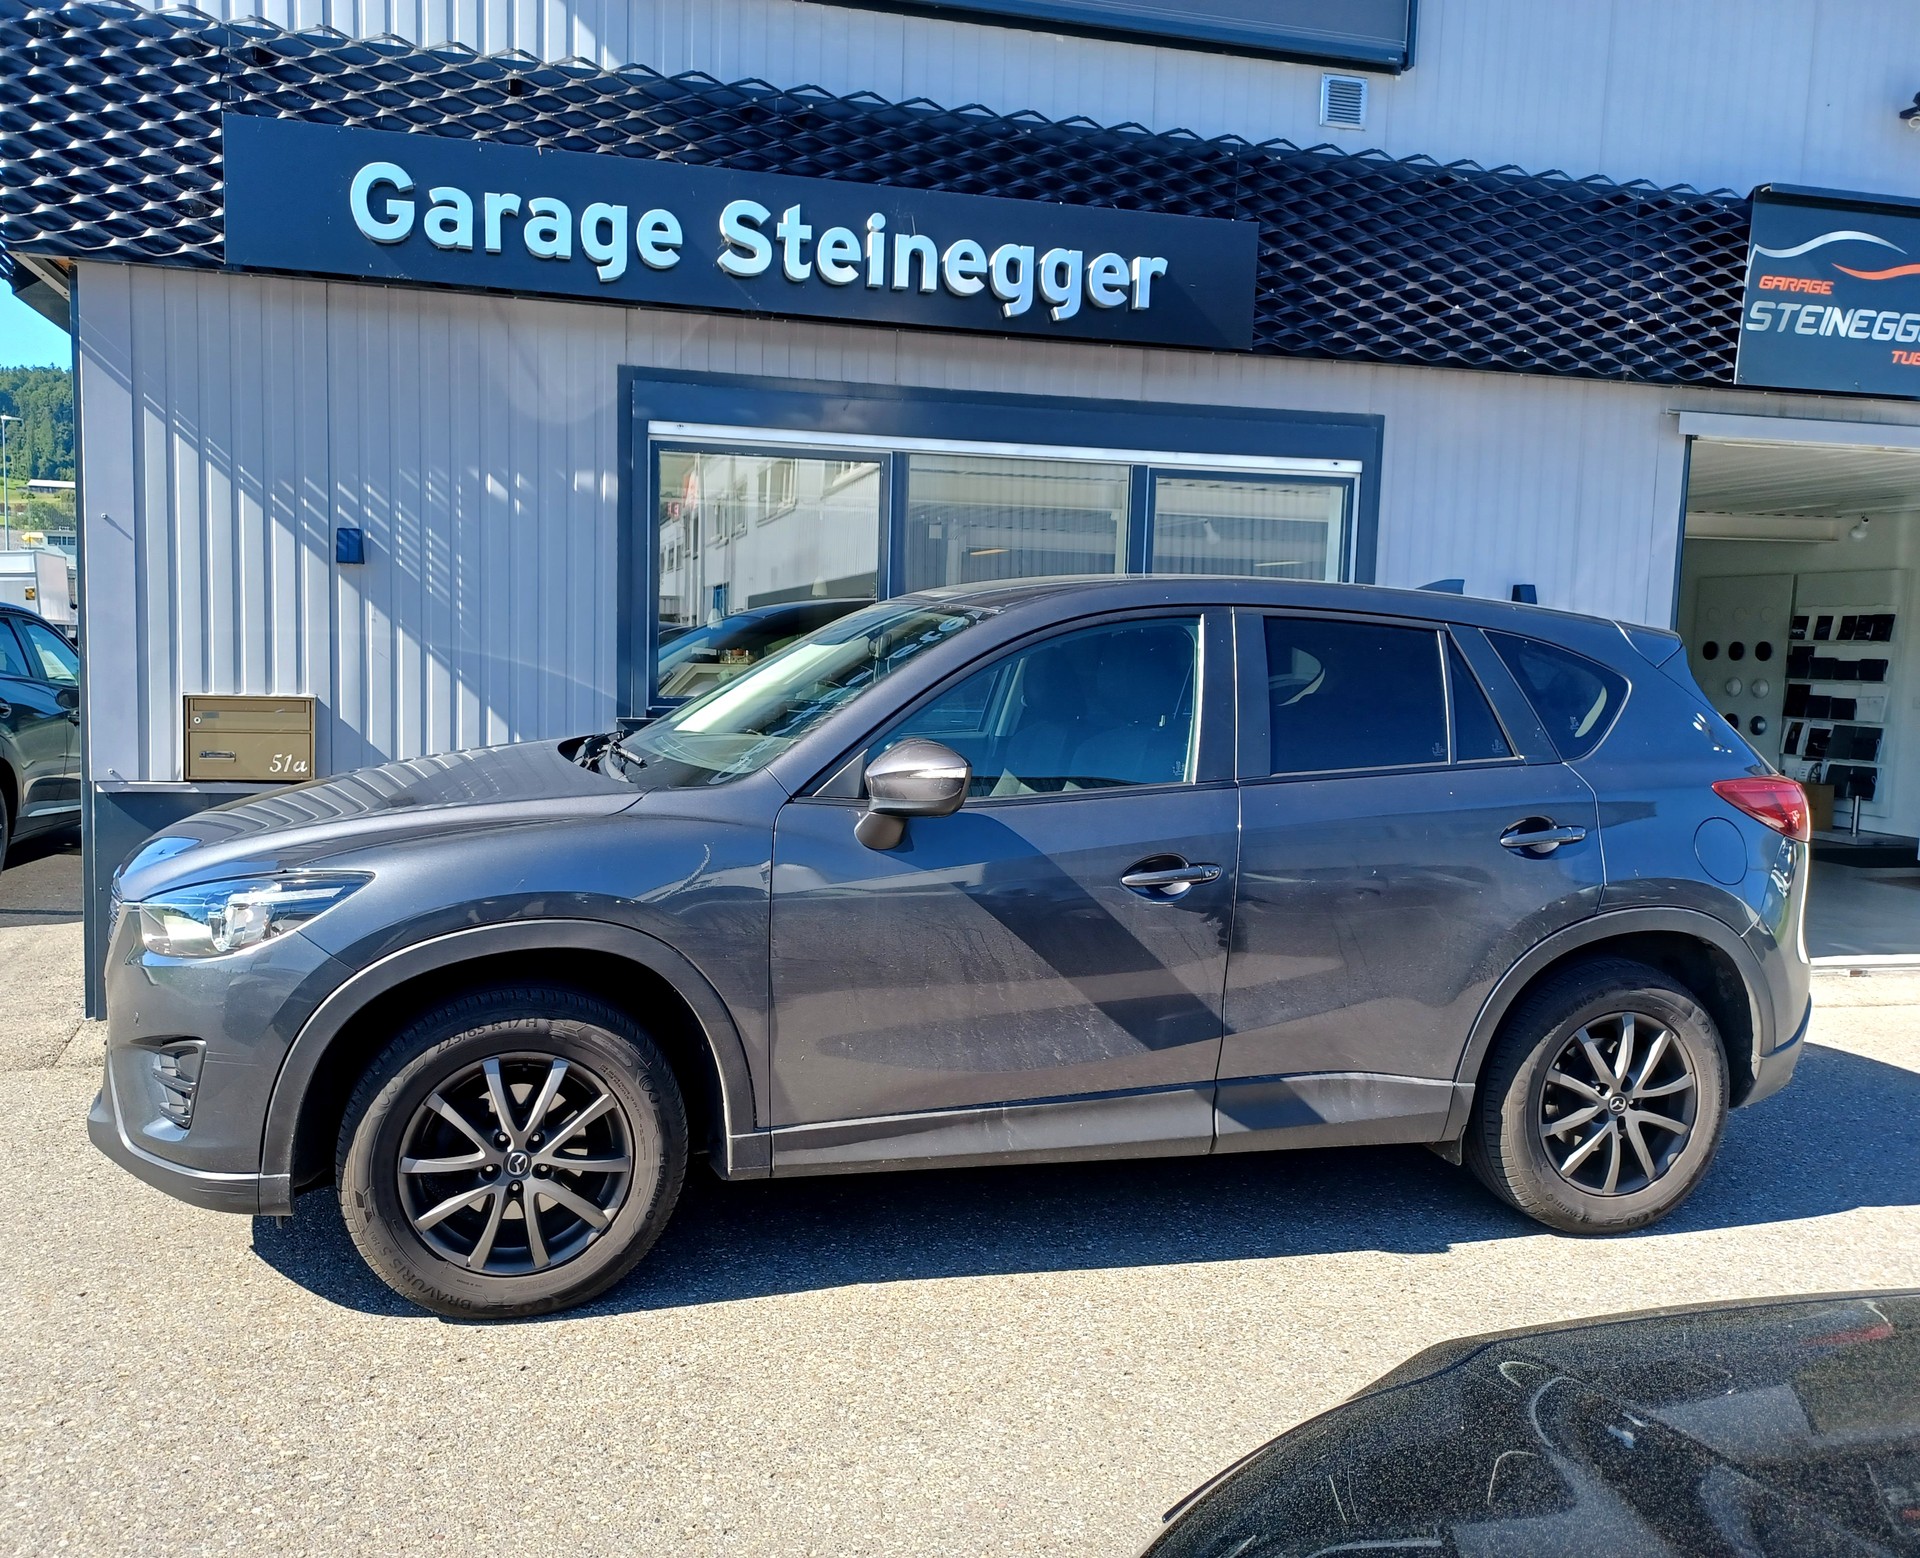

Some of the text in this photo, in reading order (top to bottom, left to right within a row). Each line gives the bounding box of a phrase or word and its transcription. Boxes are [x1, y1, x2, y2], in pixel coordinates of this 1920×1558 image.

[350, 161, 1169, 322] Garage Steinegger
[1758, 275, 1835, 296] GARAGE
[1745, 300, 1920, 343] STEINEGG
[269, 753, 308, 773] 51a
[389, 1258, 473, 1311] BRAVURIS
